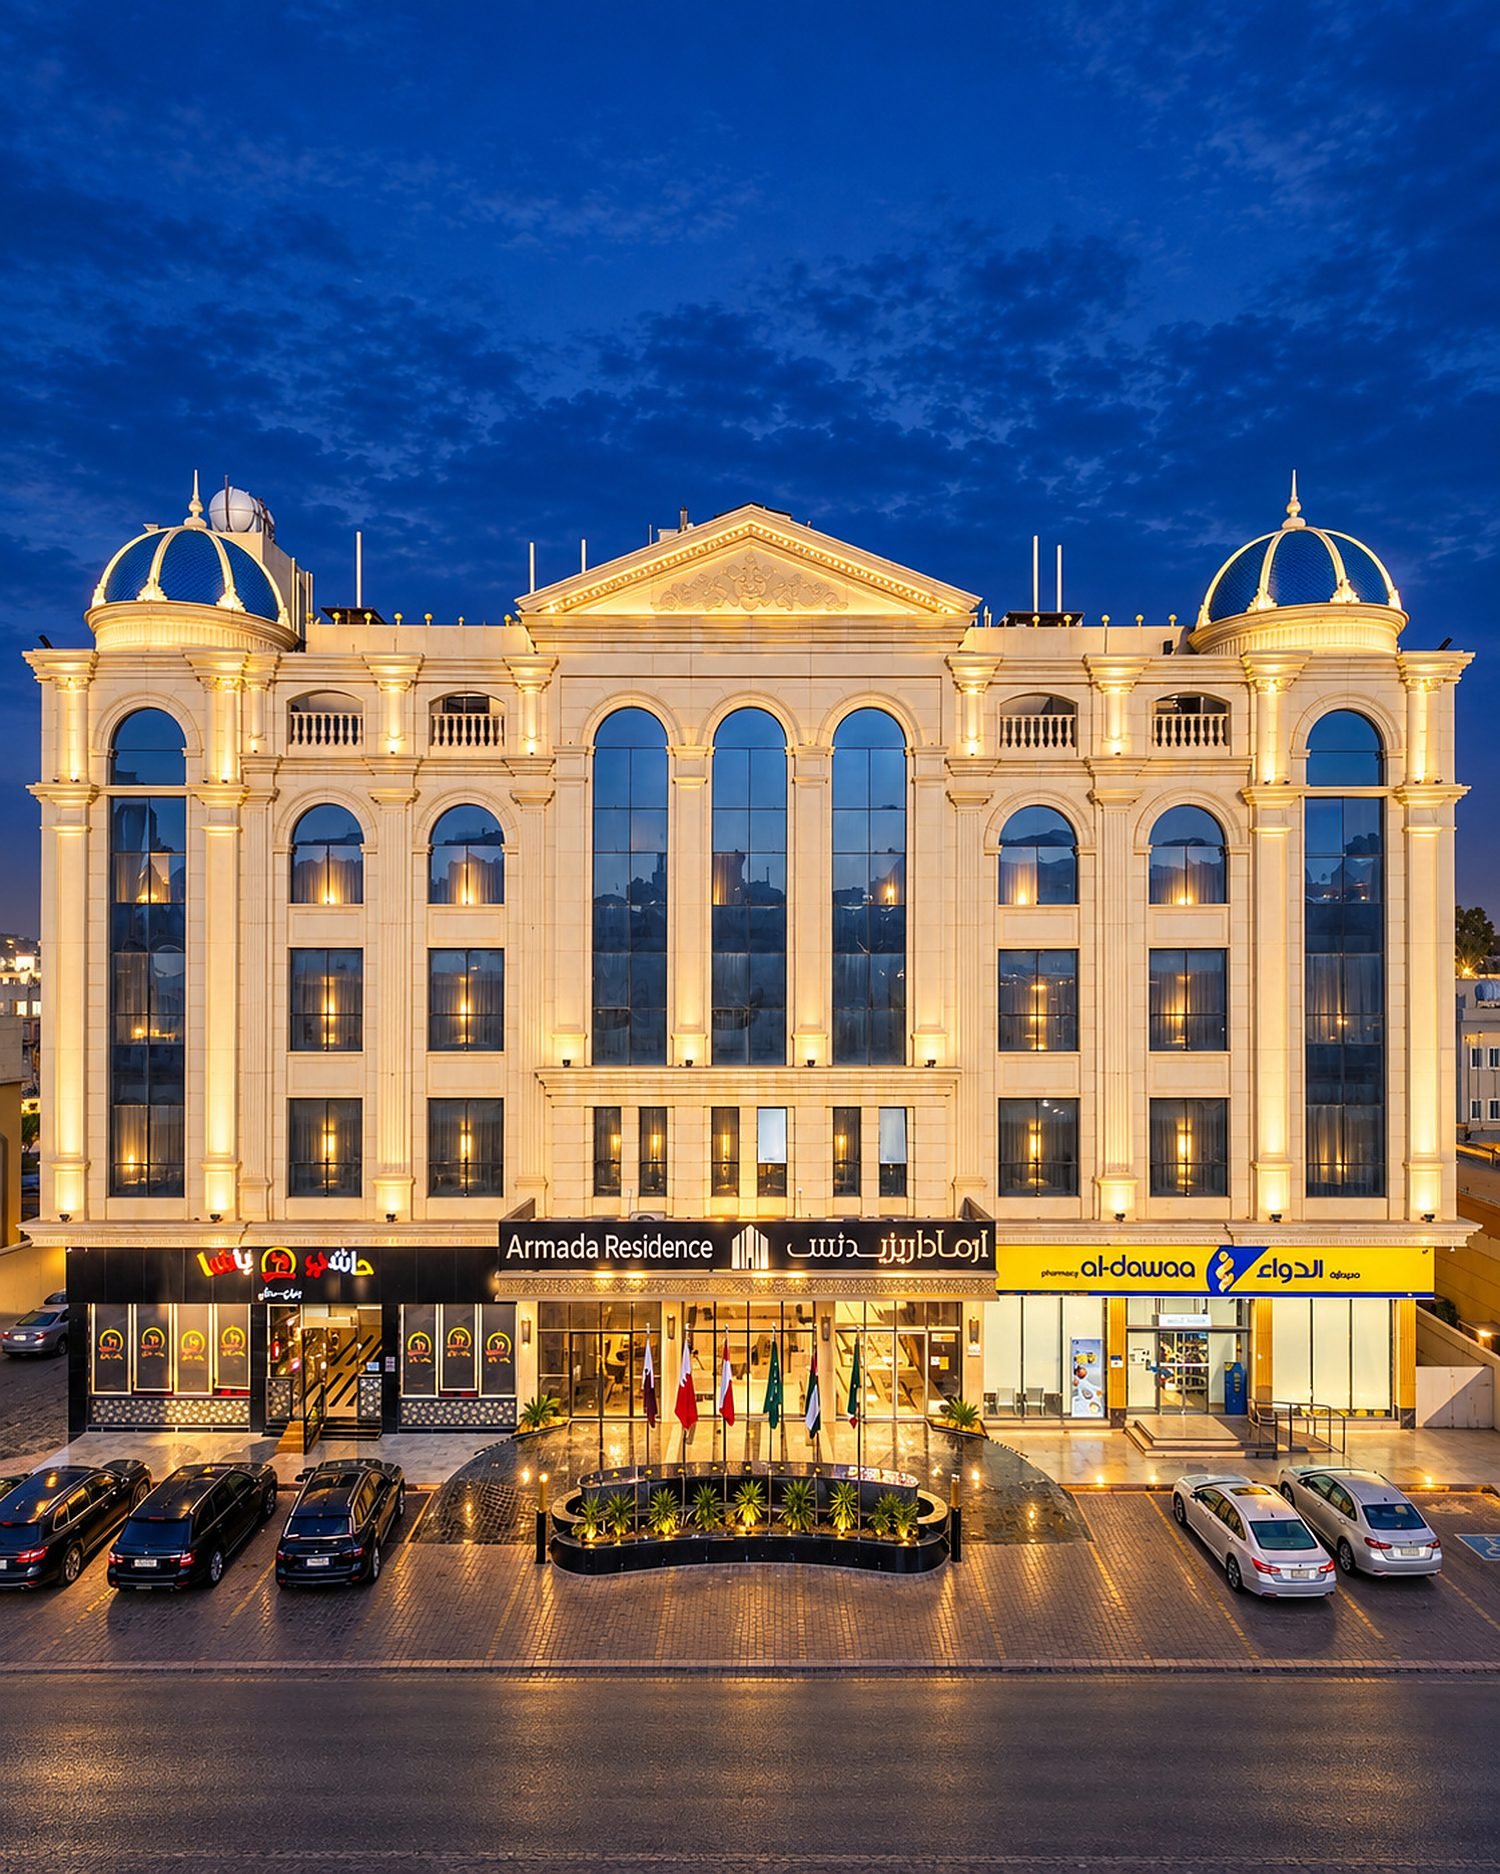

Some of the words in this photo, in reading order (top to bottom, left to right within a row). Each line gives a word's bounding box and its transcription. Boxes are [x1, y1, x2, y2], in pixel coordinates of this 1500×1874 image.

[505, 1232, 598, 1259] Armada
[604, 1232, 714, 1259] Residence
[1041, 1269, 1079, 1279] pharmacy
[1081, 1254, 1196, 1278] al-dawaa
[1256, 1257, 1324, 1284] الدواء
